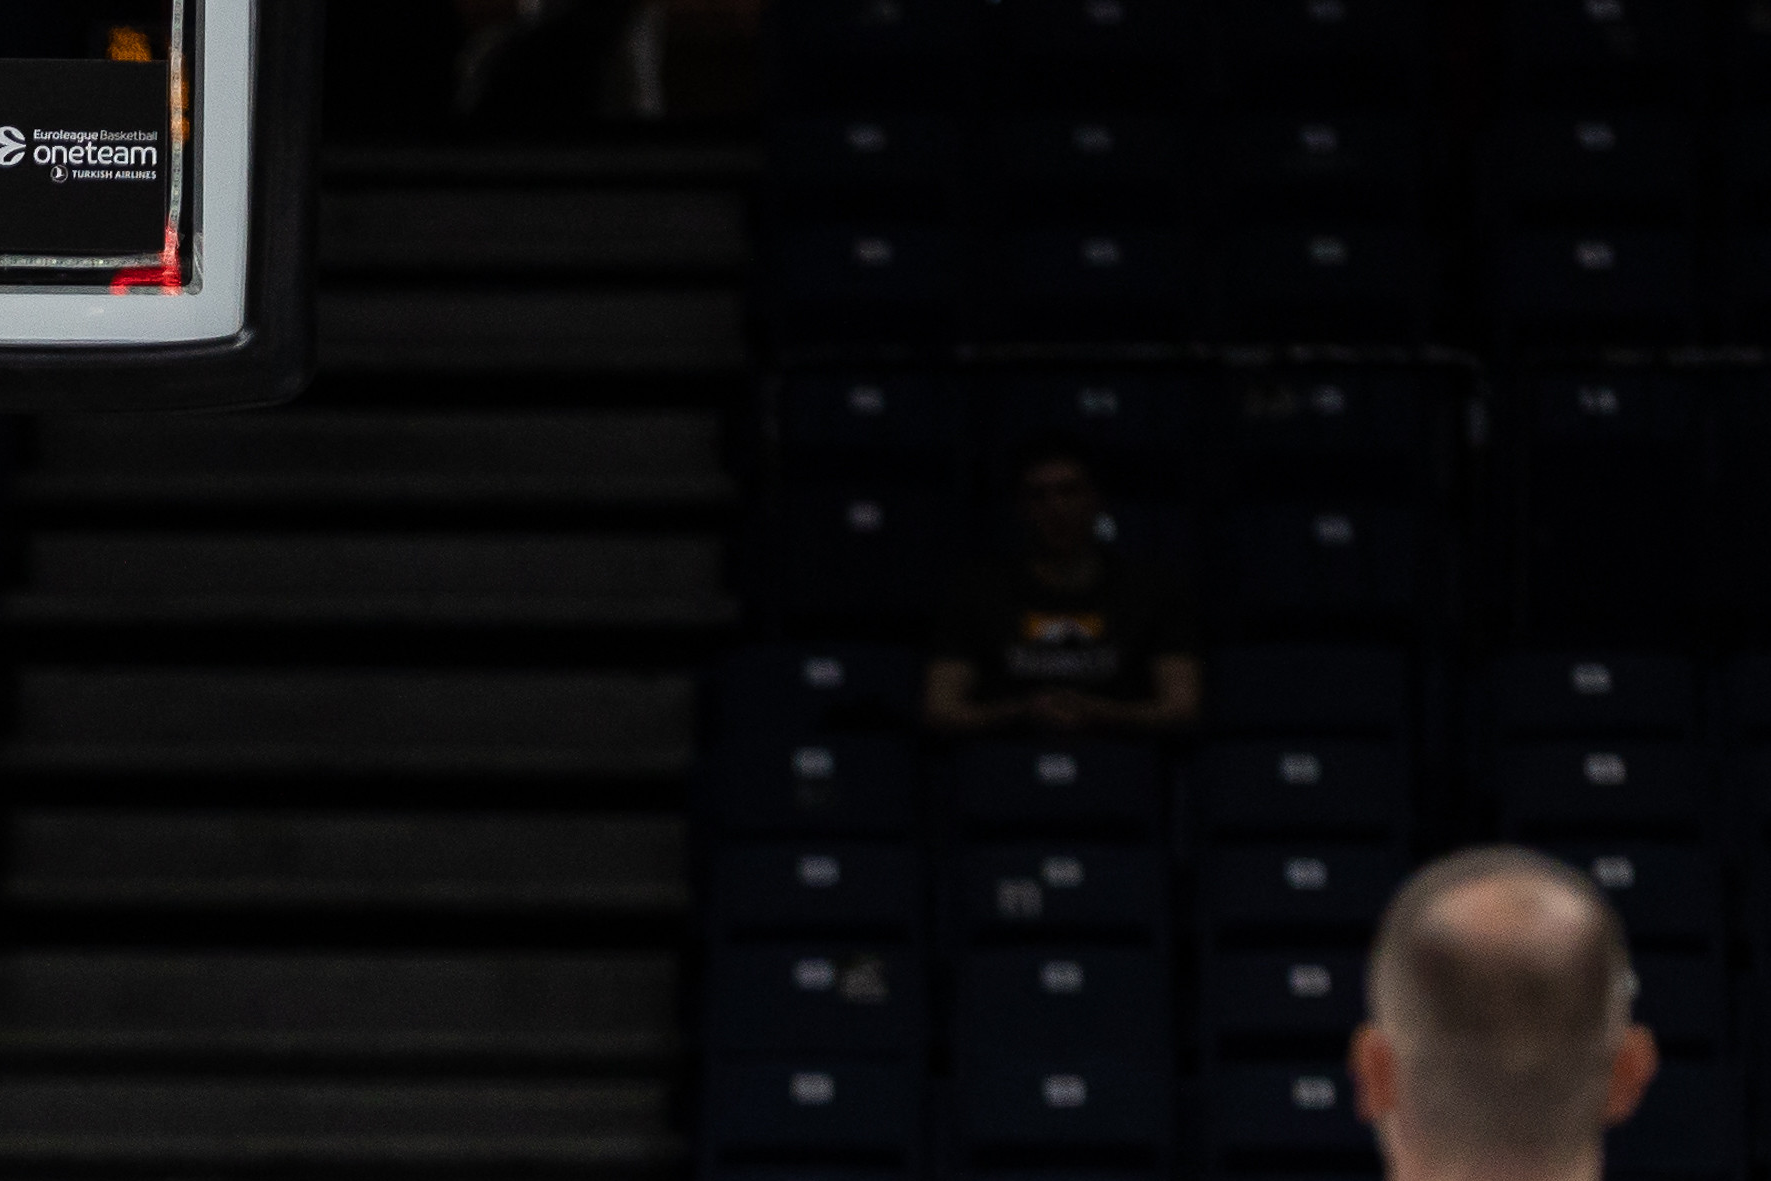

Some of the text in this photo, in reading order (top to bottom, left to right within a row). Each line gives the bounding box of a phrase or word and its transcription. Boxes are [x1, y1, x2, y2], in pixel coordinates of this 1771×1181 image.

[33, 129, 158, 143] Euroleague Basketball
[33, 142, 158, 166] oneteam
[71, 169, 157, 180] TURKISH AIRLINES
